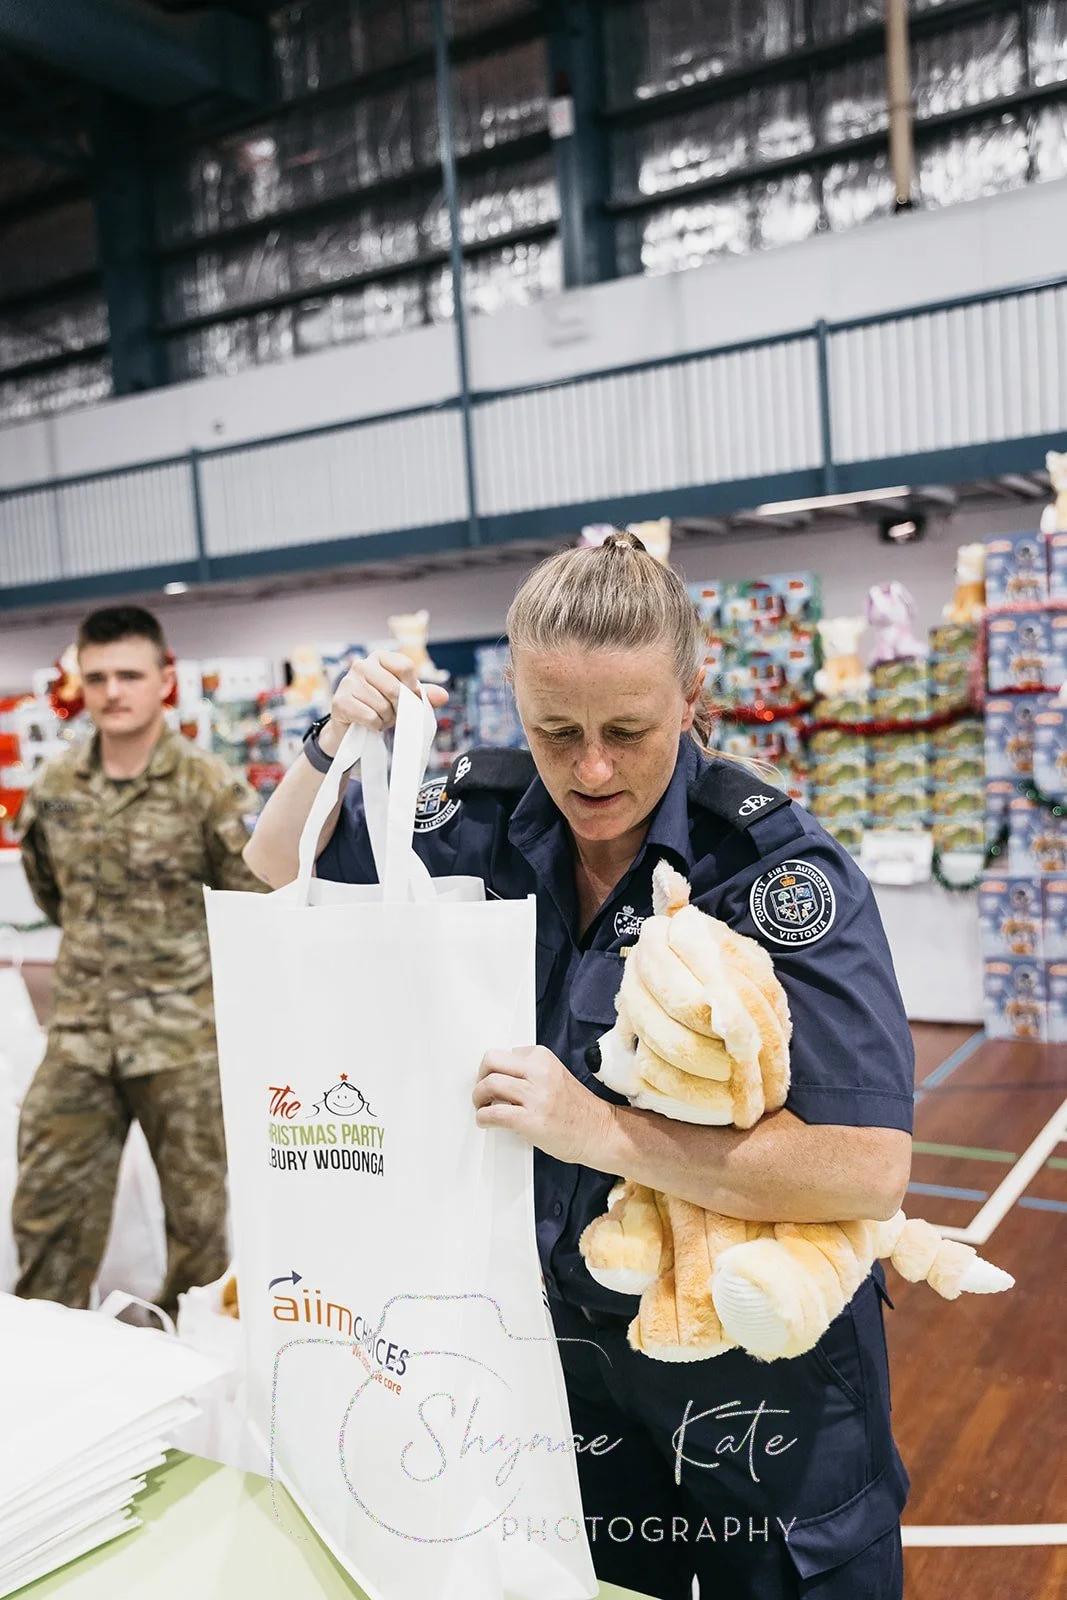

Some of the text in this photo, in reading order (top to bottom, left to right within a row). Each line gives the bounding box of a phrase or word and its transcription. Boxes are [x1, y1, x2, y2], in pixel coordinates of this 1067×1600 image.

[738, 795, 775, 816] CFA
[754, 865, 831, 923] COUNTRY FIRE AUTHORITY
[780, 919, 827, 940] VICTORIA
[269, 1085, 301, 1119] The
[269, 1123, 385, 1149] RISTMAS PARTY
[269, 1148, 384, 1177] BURY WODONGA
[384, 1377, 402, 1395] care
